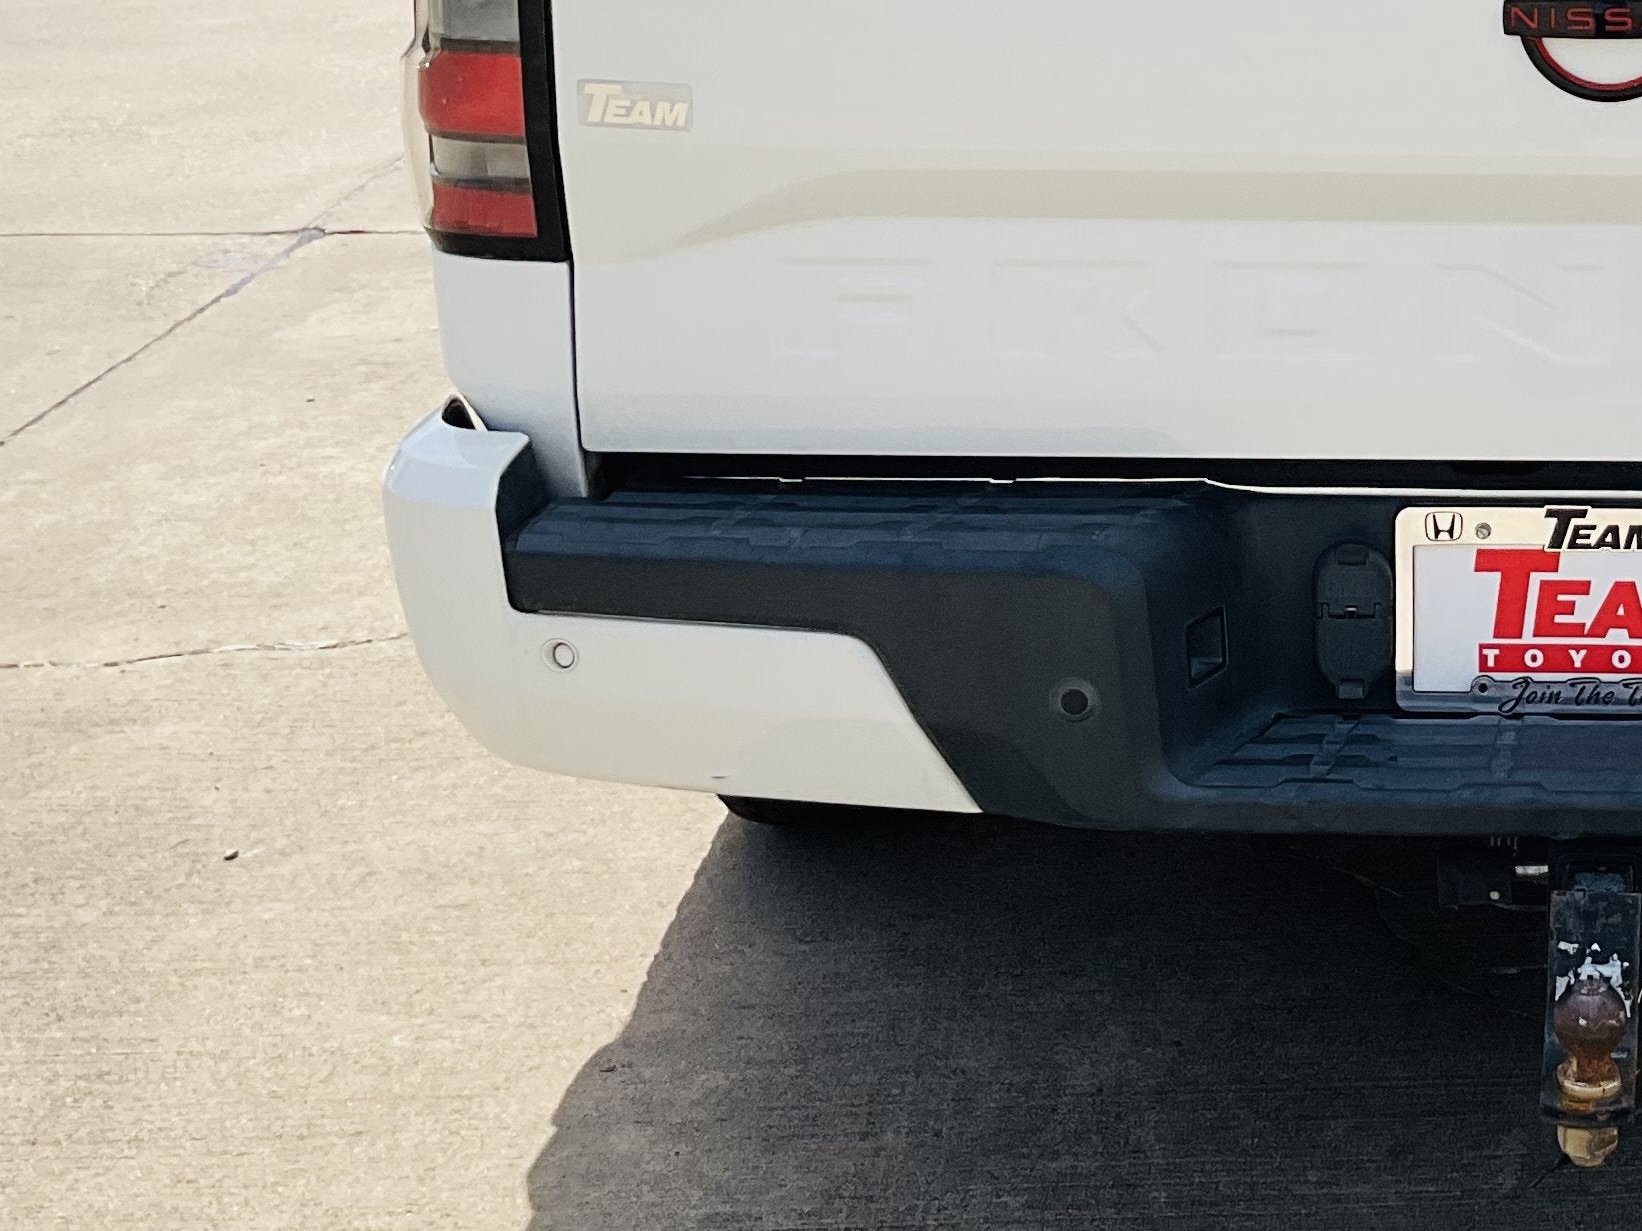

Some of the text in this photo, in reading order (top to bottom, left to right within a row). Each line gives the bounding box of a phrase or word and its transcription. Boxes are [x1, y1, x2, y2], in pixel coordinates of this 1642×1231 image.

[583, 82, 689, 127] TEAM
[1497, 676, 1563, 713] Join
[1568, 679, 1616, 706] The
